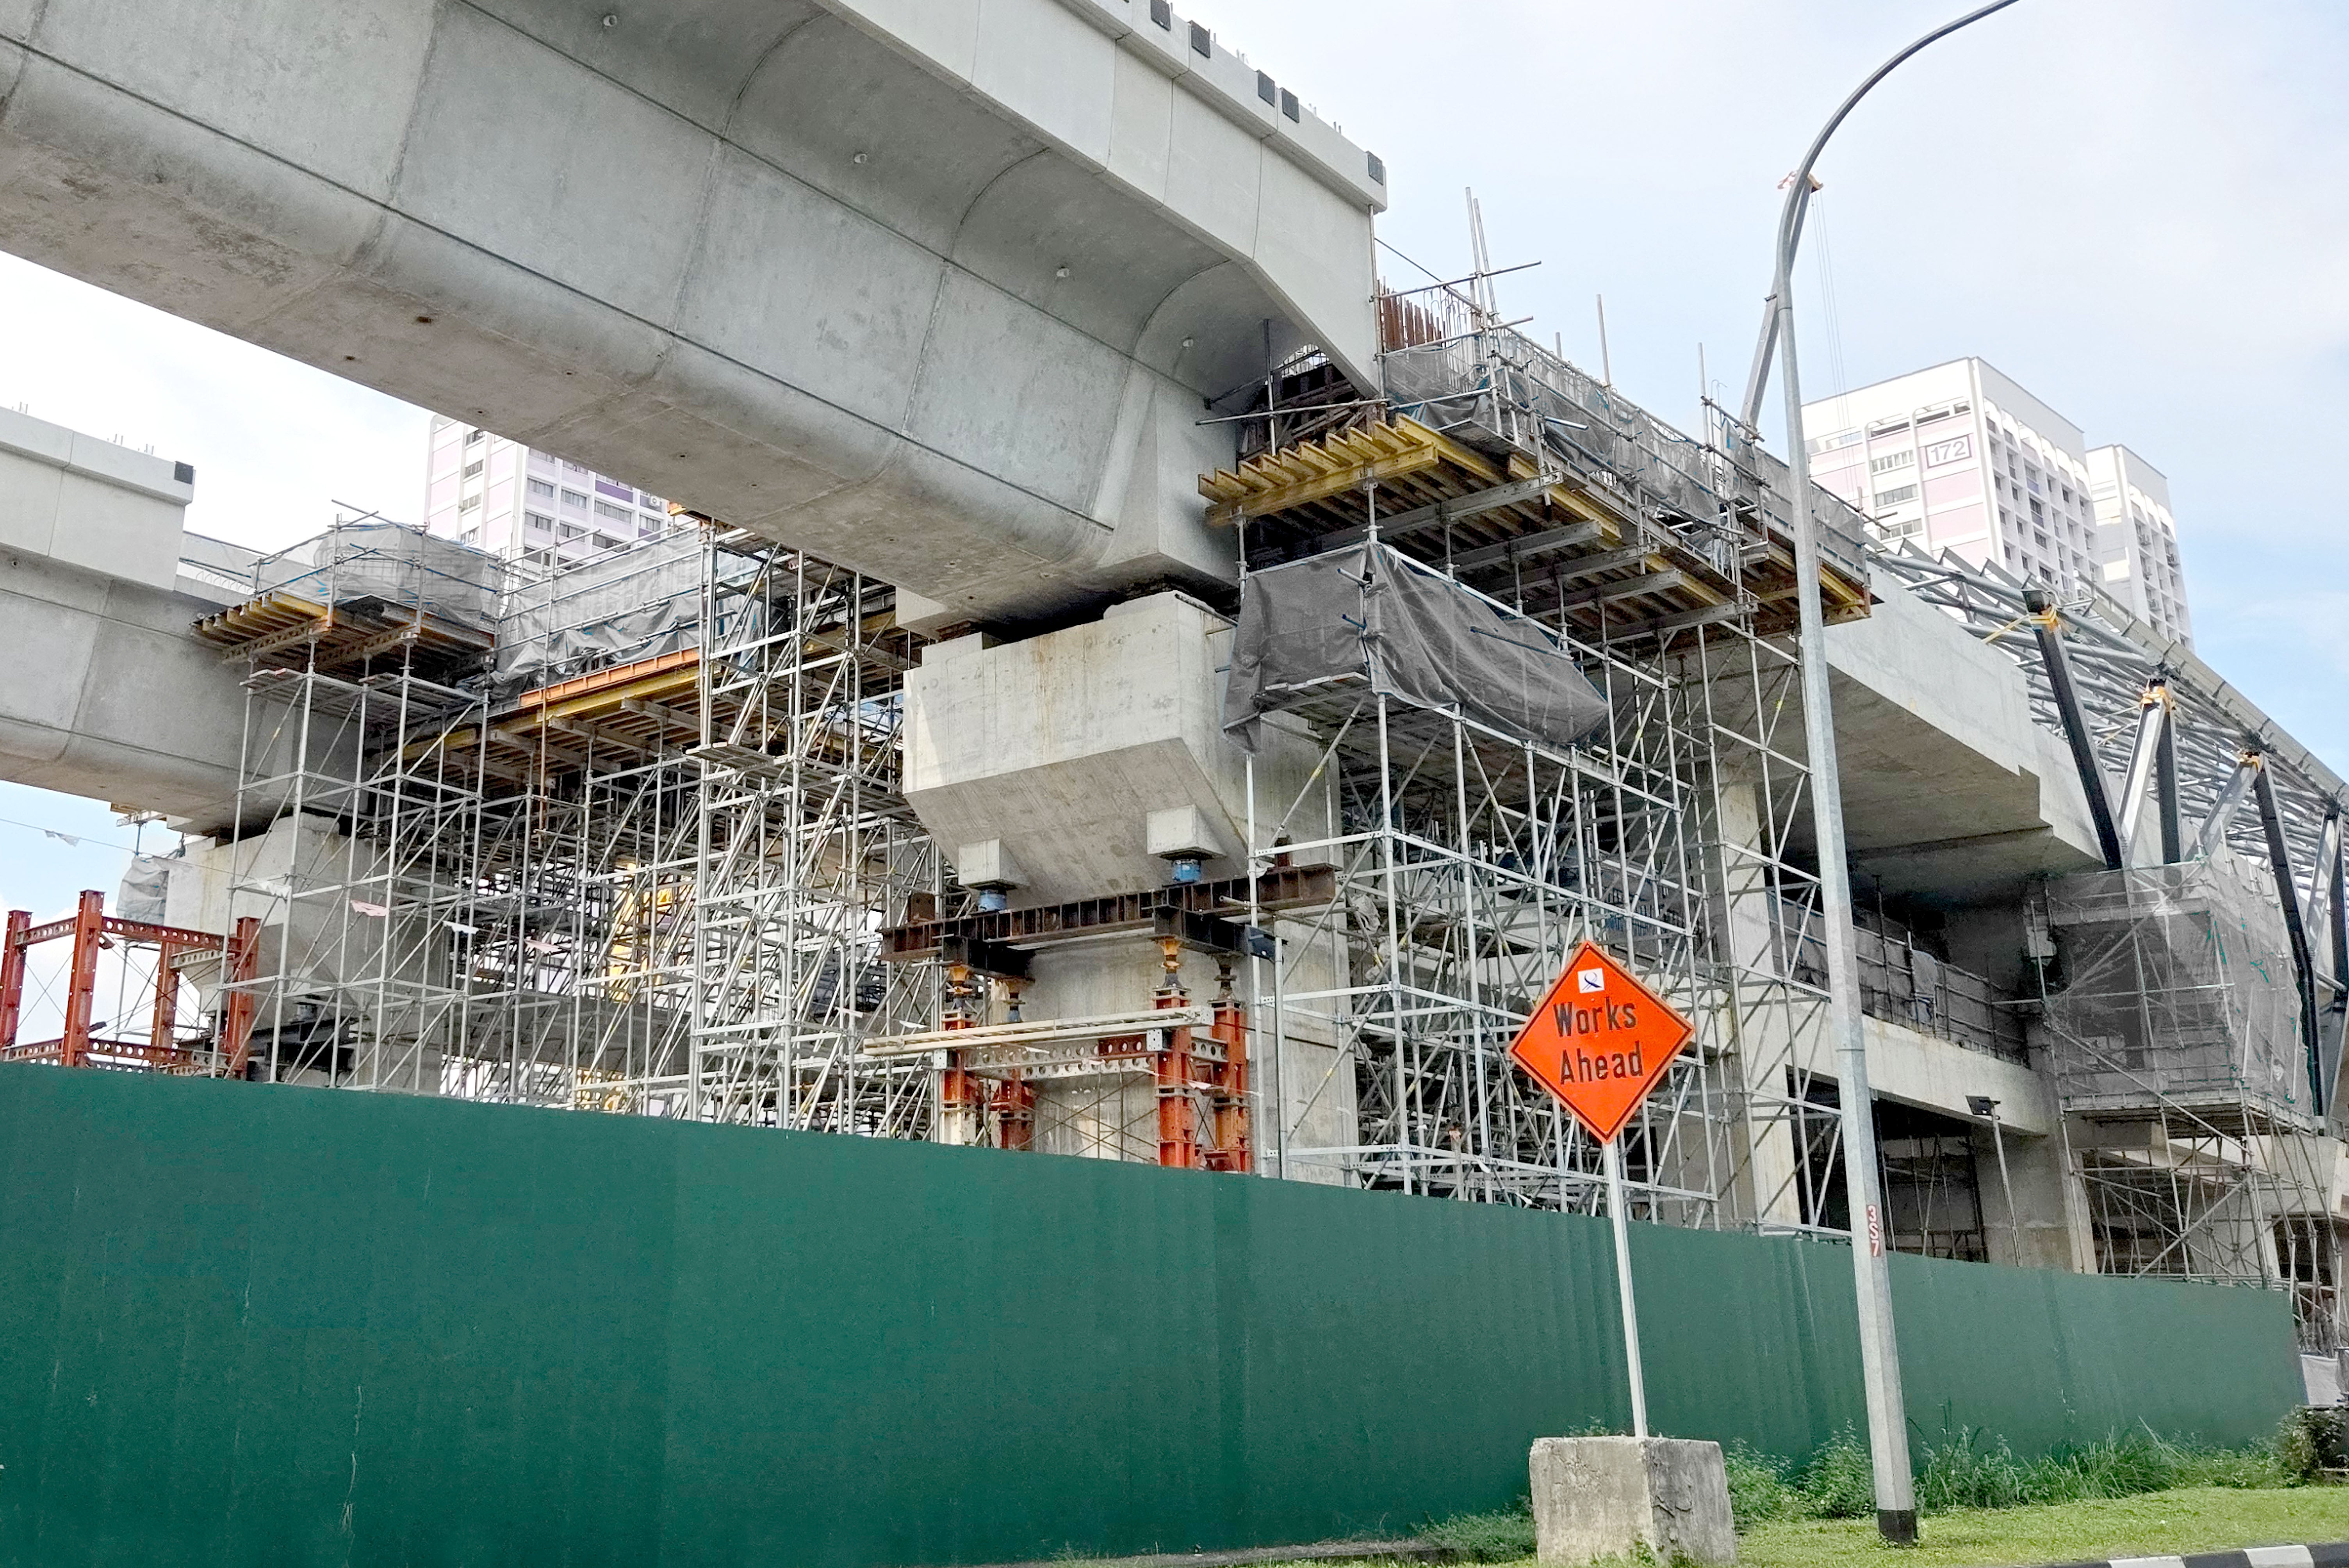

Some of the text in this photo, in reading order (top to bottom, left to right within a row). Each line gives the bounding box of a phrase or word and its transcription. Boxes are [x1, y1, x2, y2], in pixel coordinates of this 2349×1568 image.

[1930, 440, 1966, 462] 172
[1552, 996, 1638, 1037] Works
[1559, 1040, 1644, 1085] Ahead
